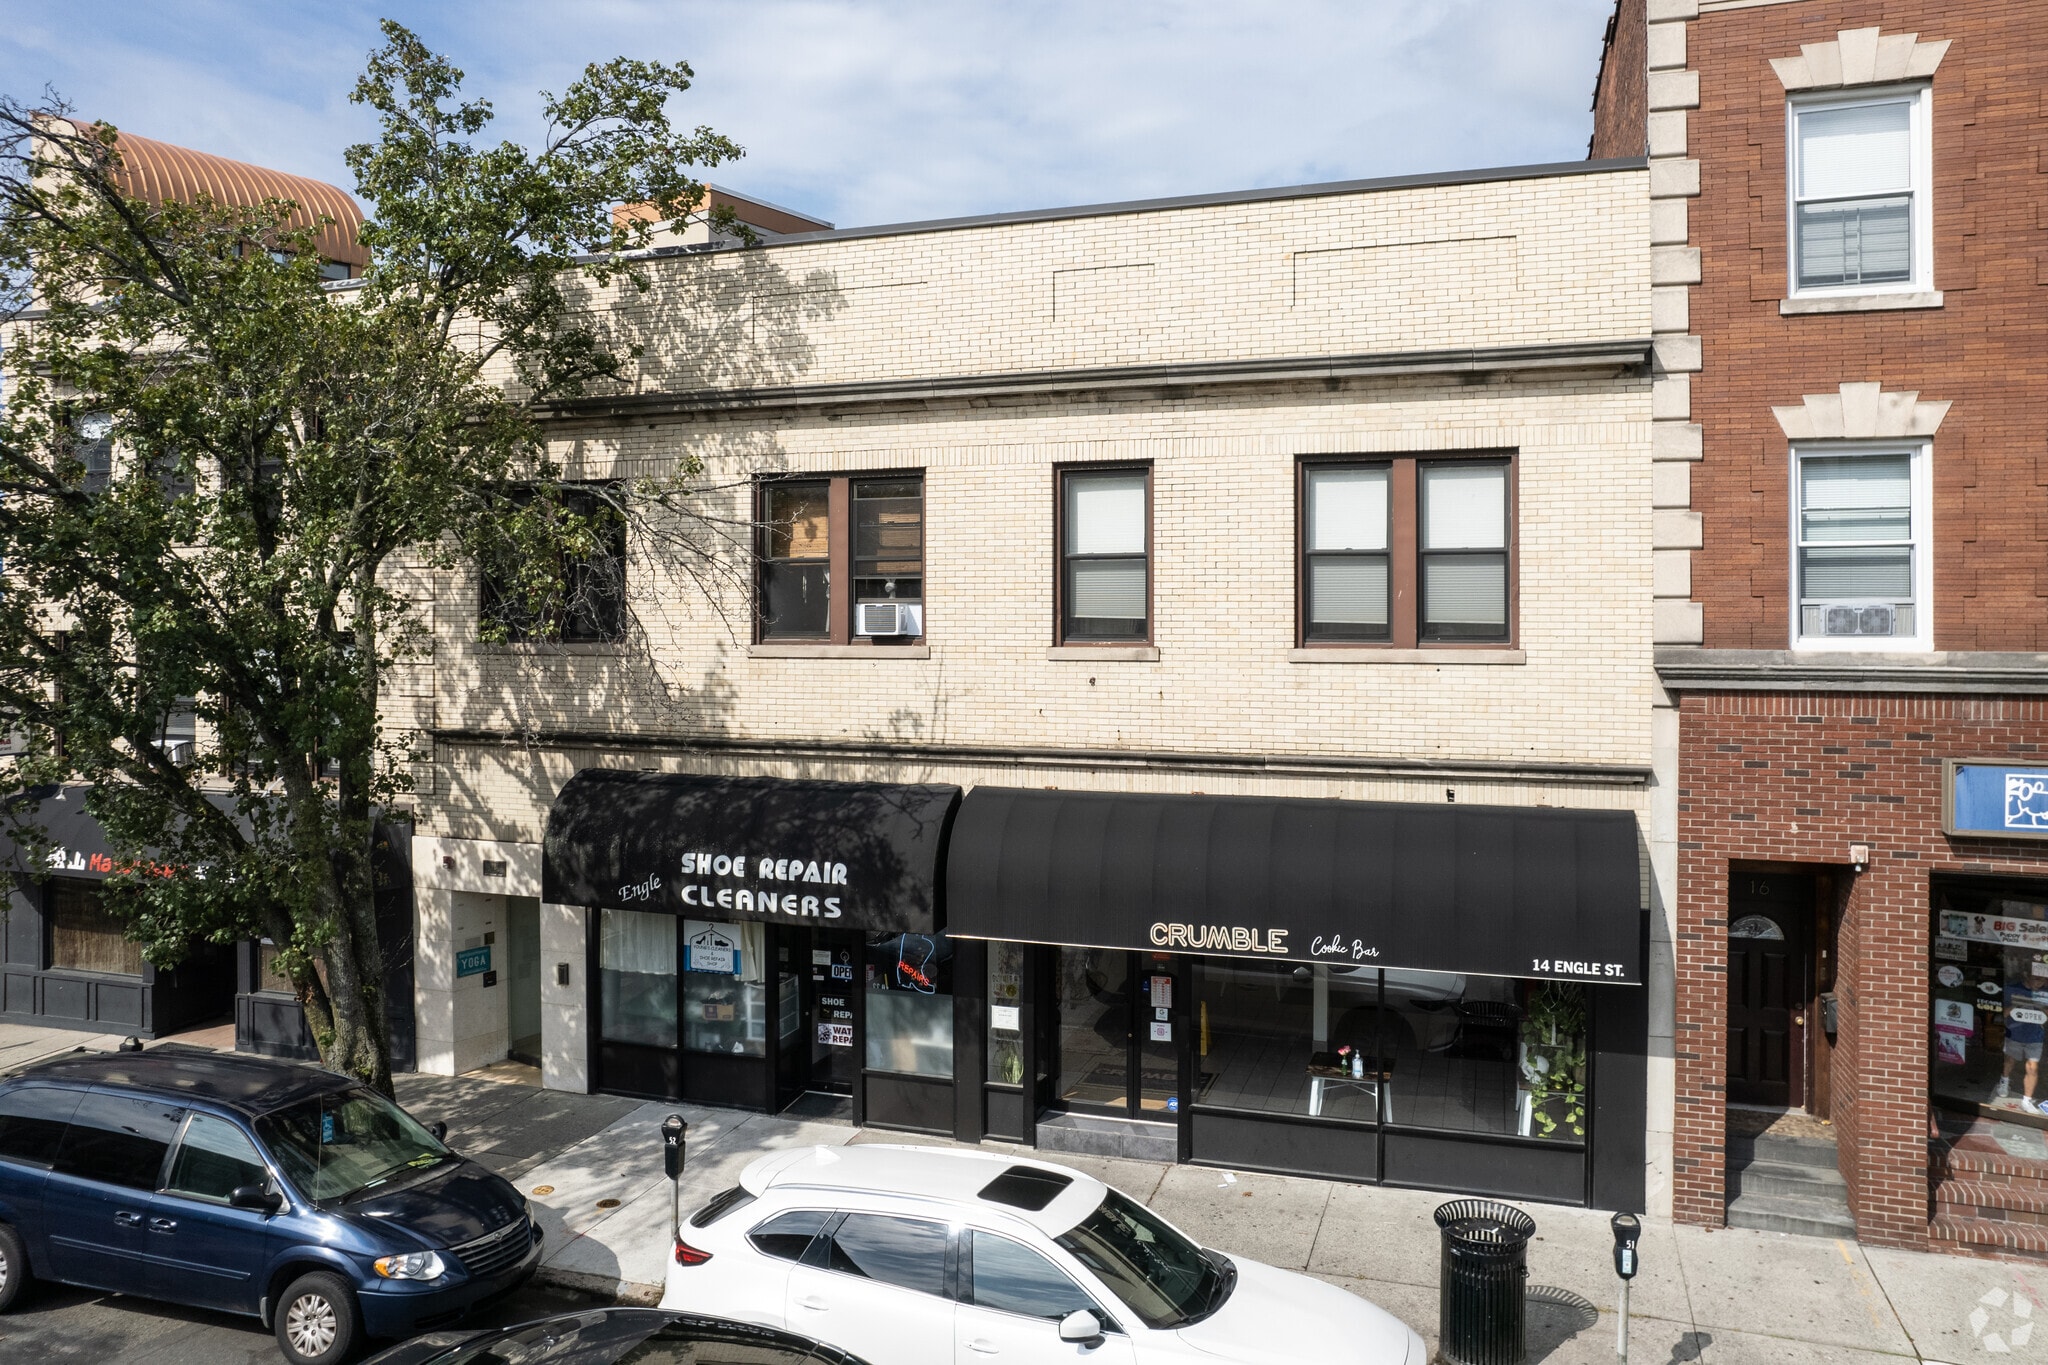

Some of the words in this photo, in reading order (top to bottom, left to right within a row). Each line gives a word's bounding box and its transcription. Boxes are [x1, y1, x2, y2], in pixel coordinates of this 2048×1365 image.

[681, 853, 746, 877] SHOE
[759, 858, 848, 885] REPAIR
[618, 872, 662, 902] Engle
[1750, 879, 1770, 896] 16
[681, 885, 842, 918] CLEANERS
[1994, 921, 2016, 931] BIG
[1150, 922, 1288, 953] CRUMBLE
[1310, 934, 1348, 956] Cookie
[1351, 939, 1380, 959] Bar
[461, 955, 486, 970] YOGA
[1532, 959, 1550, 972] 14
[1554, 960, 1601, 975] ENGLE
[1604, 963, 1625, 977] ST.
[898, 961, 930, 987] REPAIRS
[821, 997, 845, 1006] SHOE
[2024, 1012, 2042, 1021] OPEN
[669, 1136, 677, 1144] 52
[1626, 1240, 1635, 1249] 51
